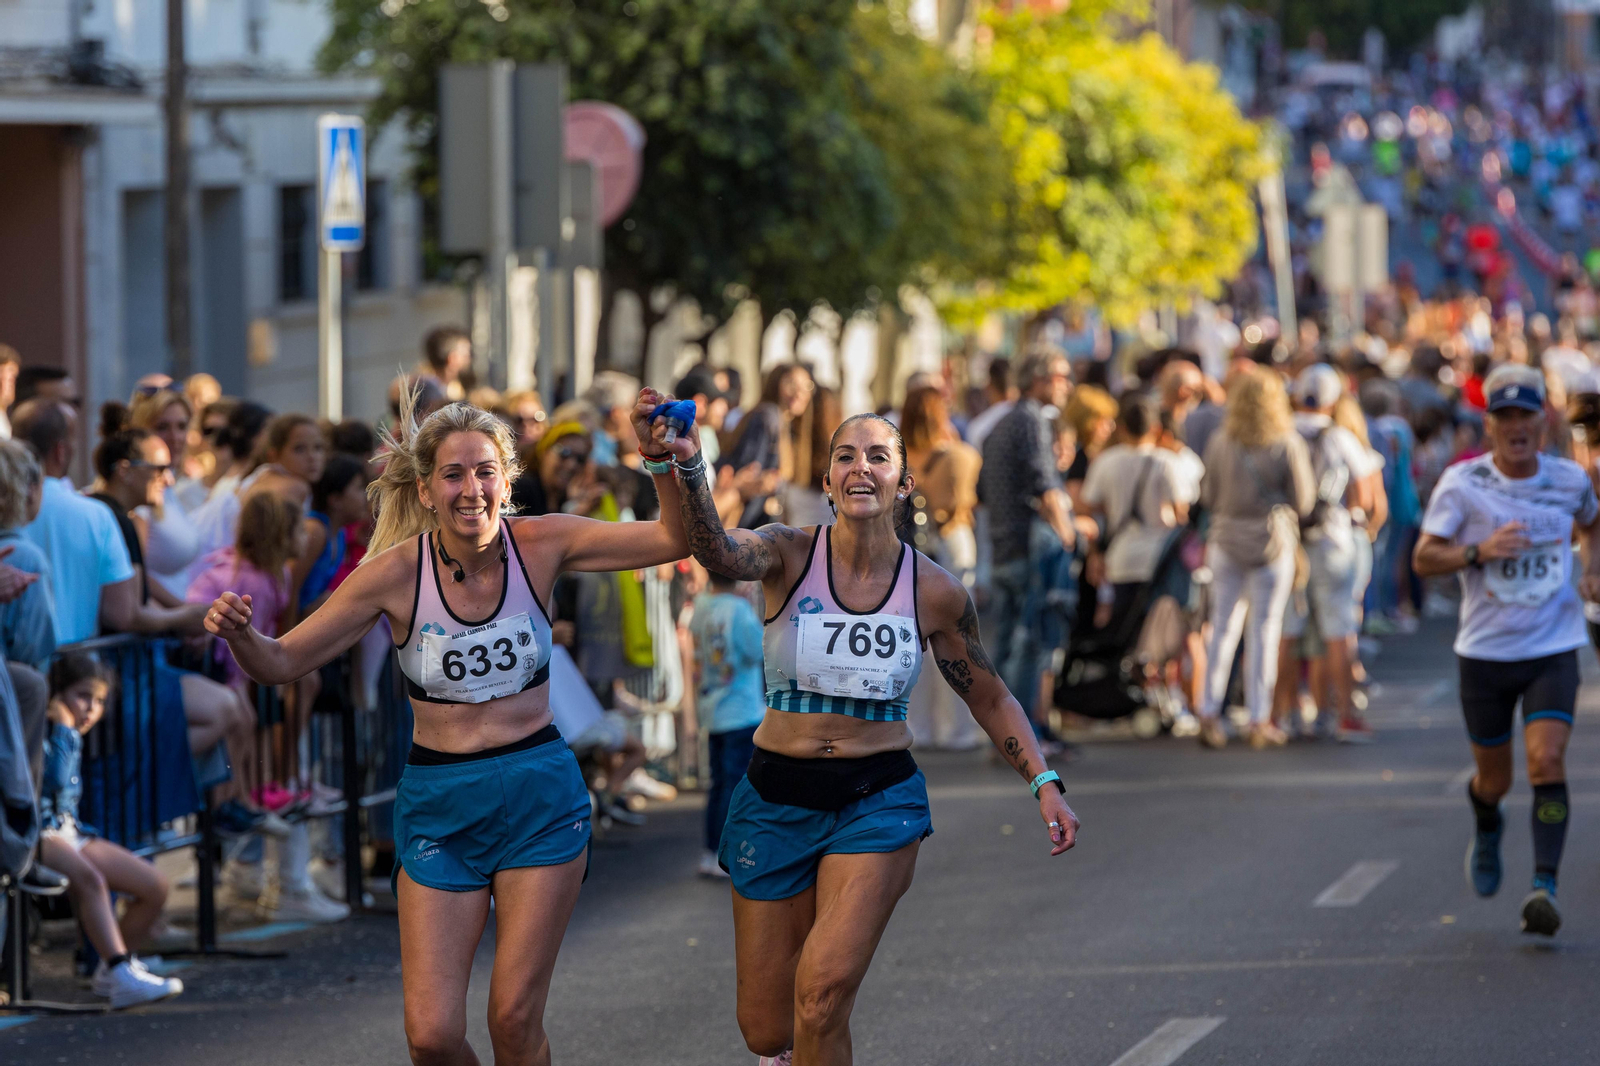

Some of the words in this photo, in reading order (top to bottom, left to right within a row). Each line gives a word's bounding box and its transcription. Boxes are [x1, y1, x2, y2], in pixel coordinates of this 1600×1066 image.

[1502, 554, 1548, 581] 615
[467, 626, 487, 637] CARMONA
[823, 621, 897, 659] 769
[442, 637, 518, 682] 633
